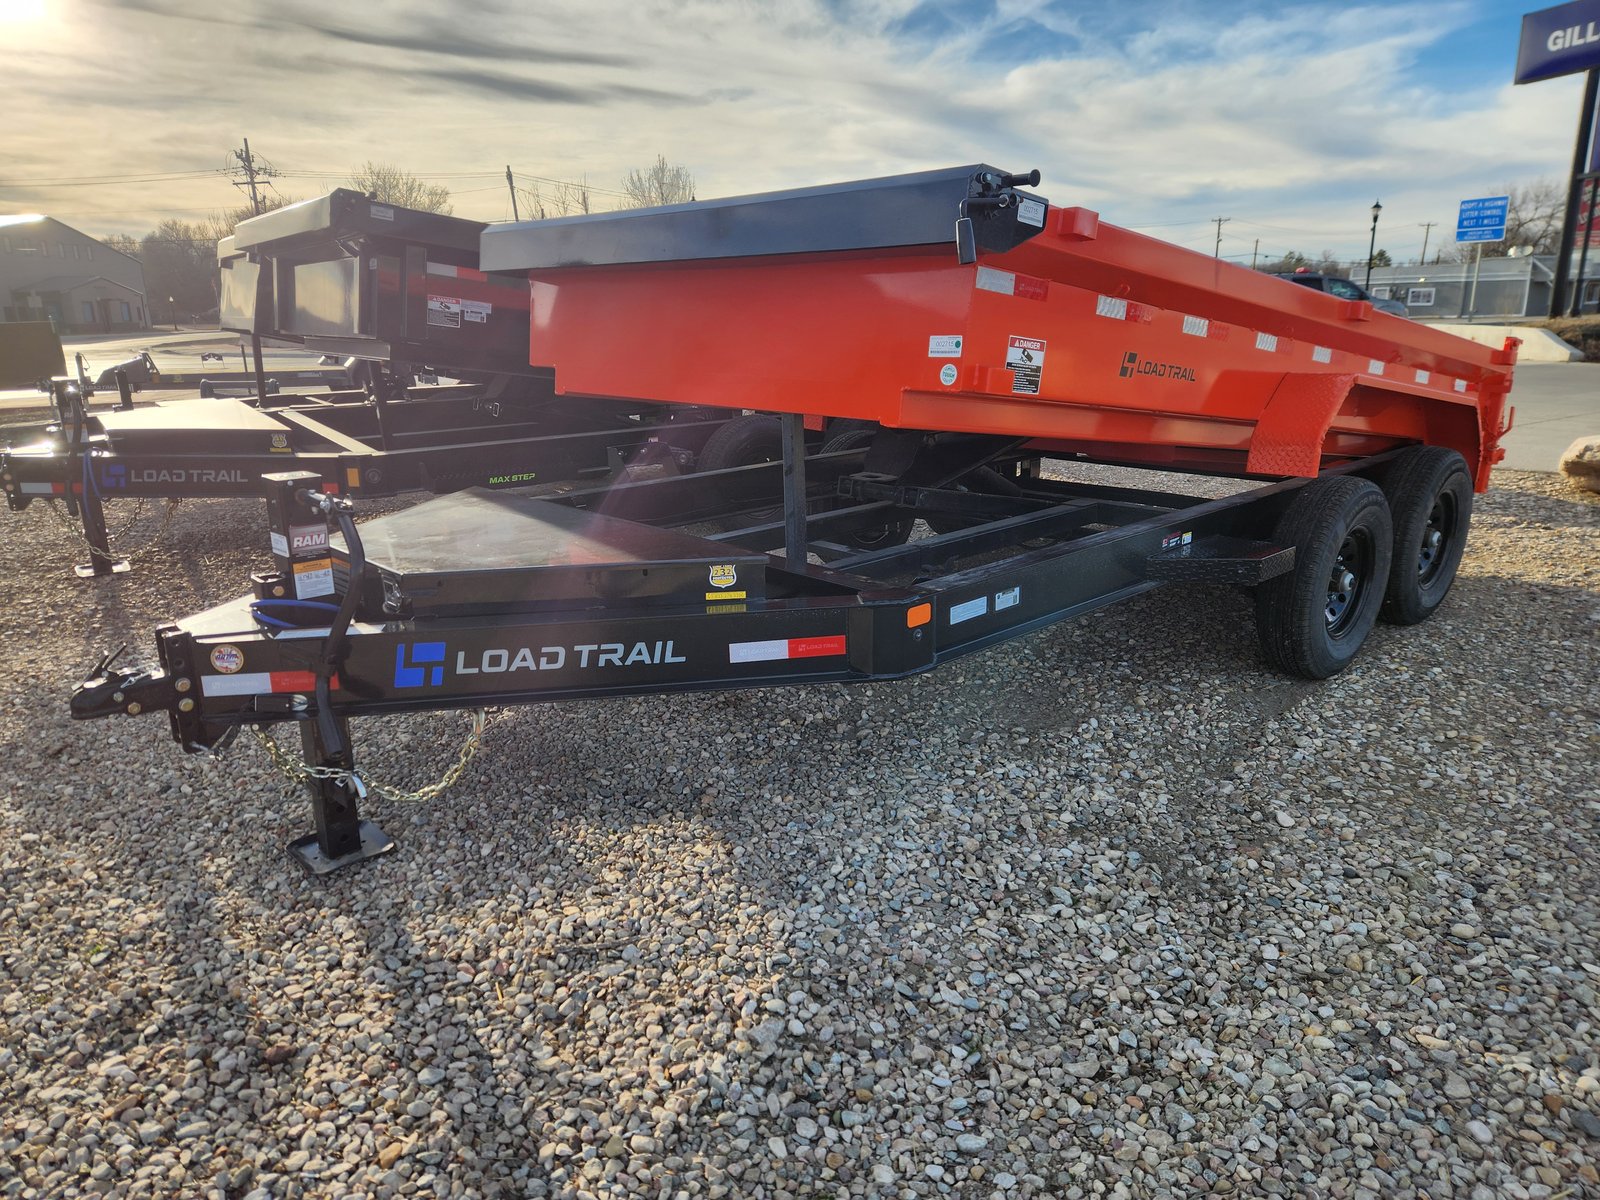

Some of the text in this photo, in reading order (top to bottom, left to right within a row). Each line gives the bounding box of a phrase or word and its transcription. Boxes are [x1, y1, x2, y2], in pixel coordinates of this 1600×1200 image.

[1483, 217, 1500, 225] MILES
[1020, 339, 1041, 350] DANGER
[1136, 359, 1196, 382] LOAD TRAIL
[131, 469, 249, 483] LOAD TRAIL
[489, 473, 536, 484] MAX STEP
[293, 533, 326, 548] RAM
[455, 646, 566, 675] LOAD
[573, 640, 687, 668] TRAIL
